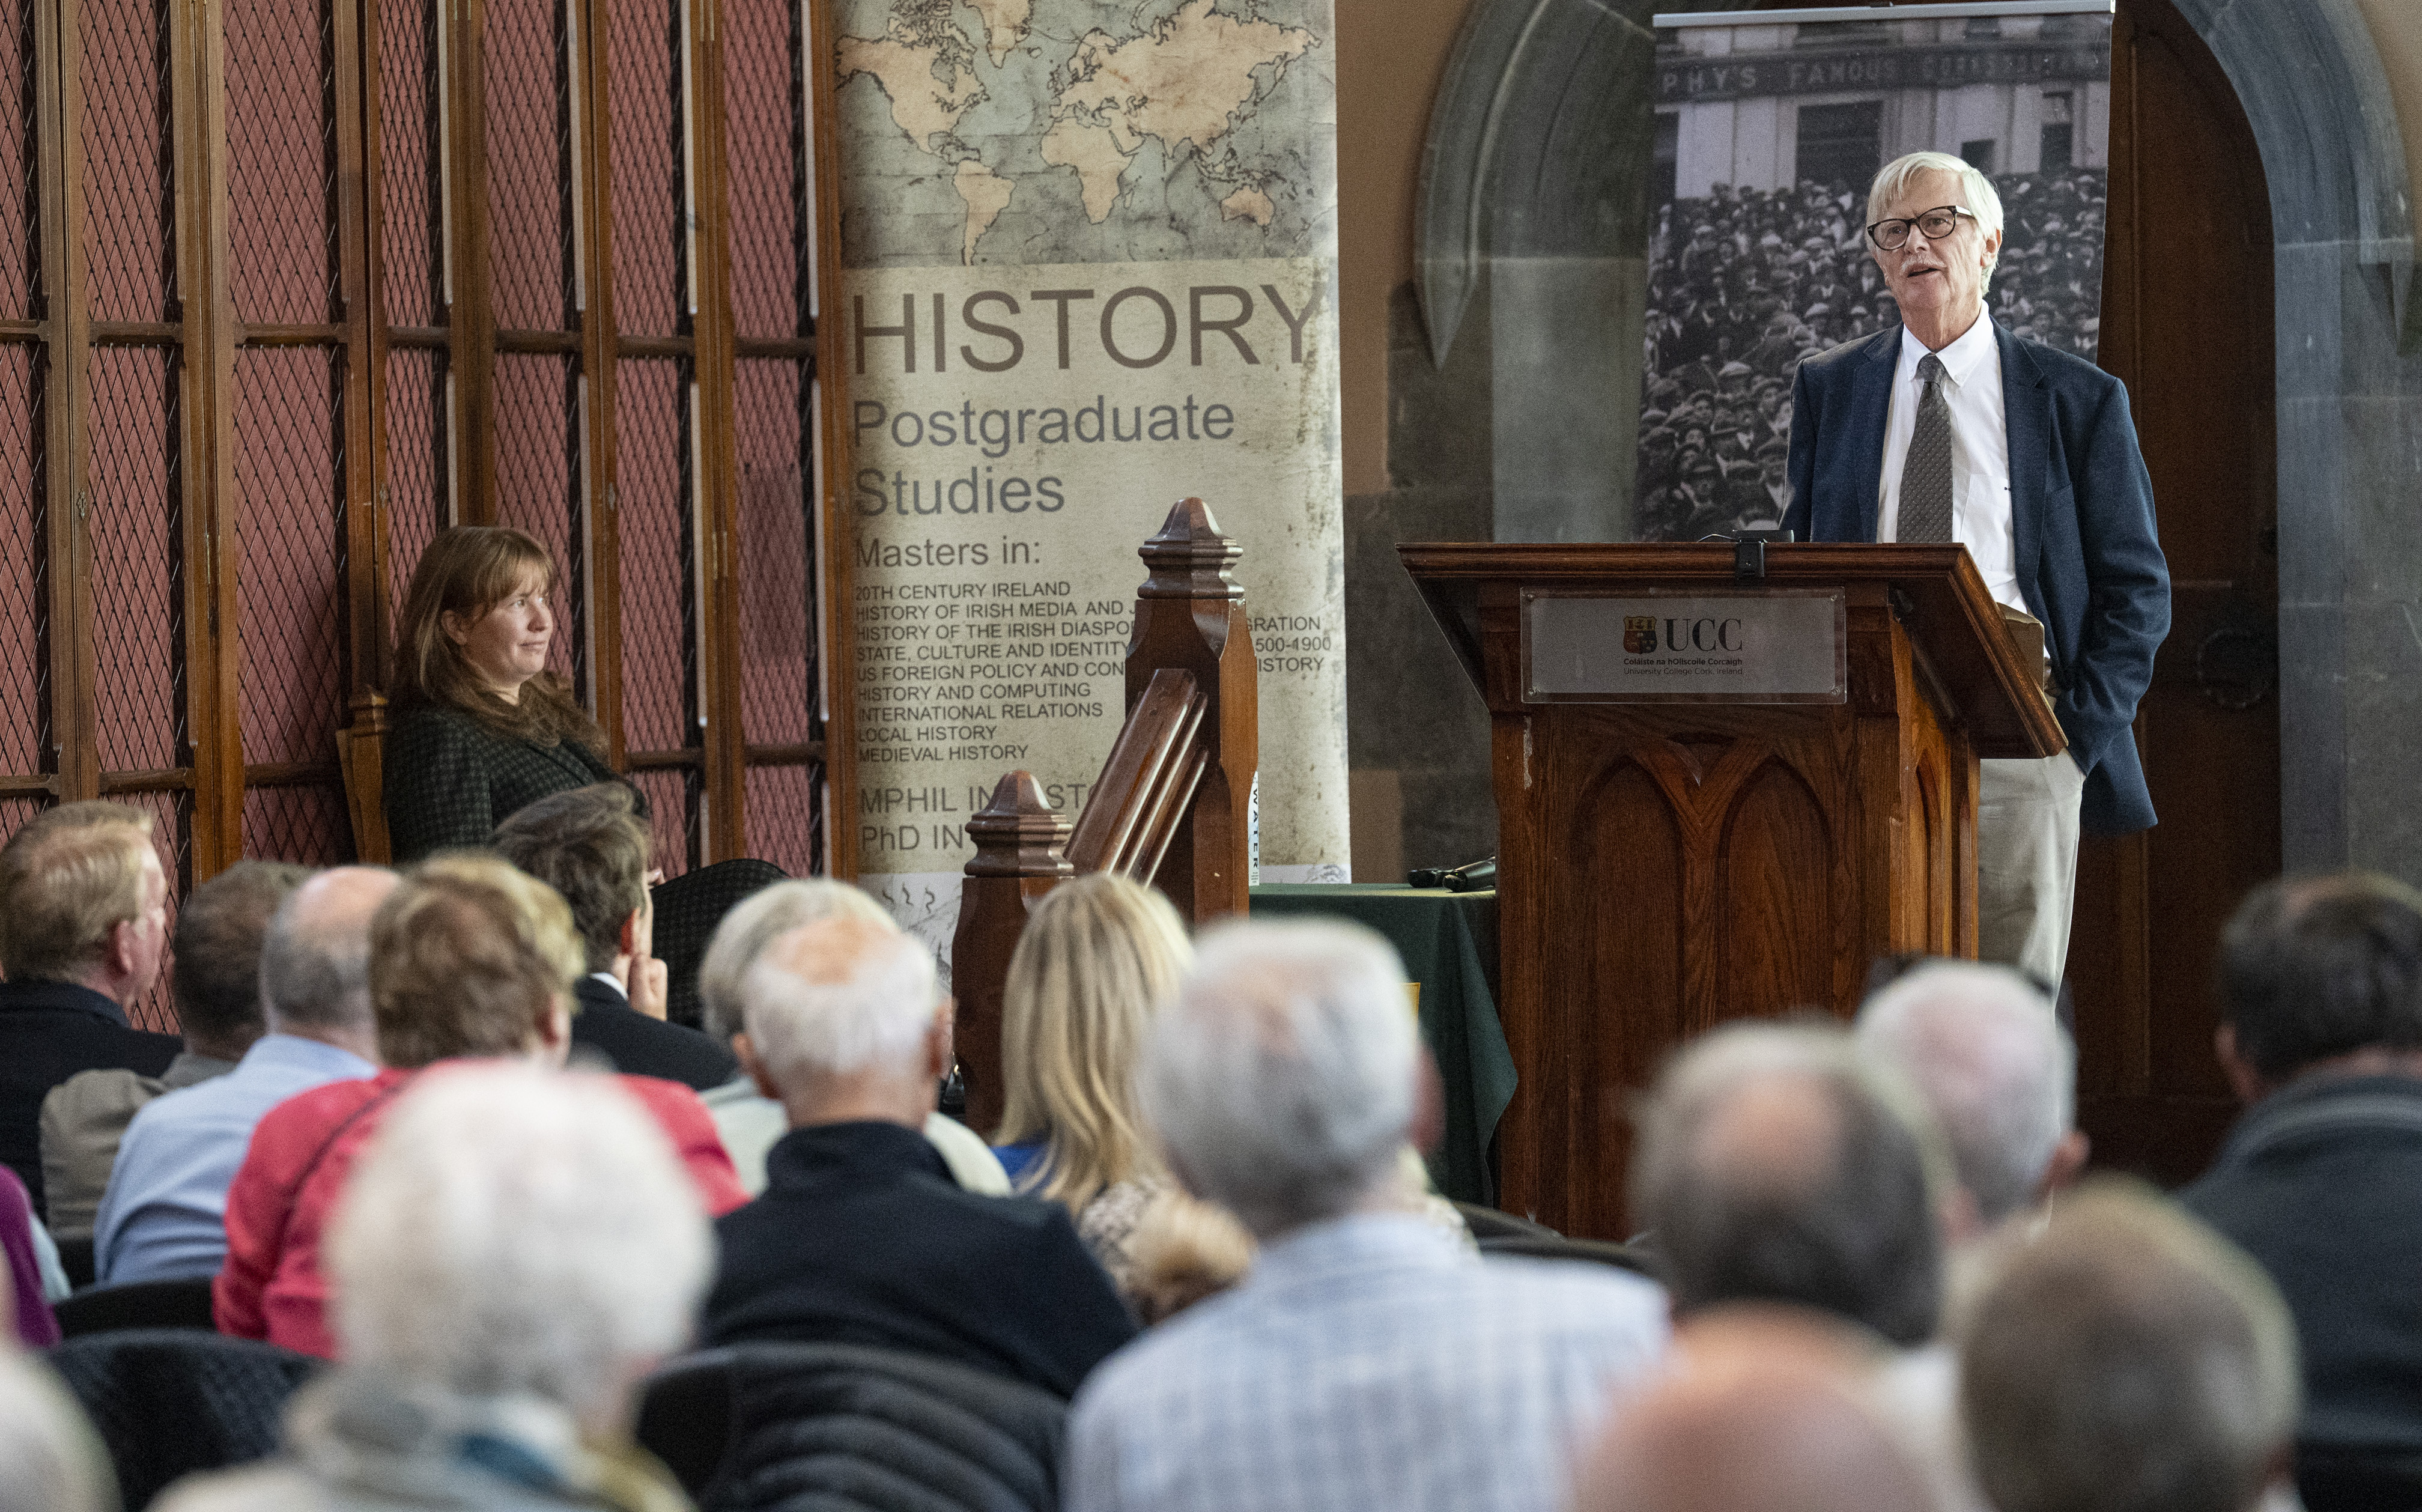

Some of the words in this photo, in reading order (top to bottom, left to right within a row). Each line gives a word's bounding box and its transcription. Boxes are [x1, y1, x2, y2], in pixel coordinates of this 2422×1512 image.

[853, 284, 1322, 375] HISTORY
[854, 395, 1234, 458] Postgraduate
[855, 467, 1064, 517] Studies
[856, 538, 989, 568] Masters
[1003, 535, 1040, 564] in:
[855, 586, 893, 601] 20TH
[899, 583, 986, 599] CENTURY
[992, 581, 1070, 597] IRELAND
[857, 606, 928, 621] HISTORY
[935, 605, 959, 619] OF
[966, 604, 1013, 618] IRISH
[1021, 603, 1076, 616] MEDIA
[1085, 601, 1123, 615] AND
[857, 626, 929, 641] HISTORY
[936, 625, 960, 639] OF
[965, 624, 1001, 639] THE
[1007, 622, 1055, 637] IRISH
[1062, 621, 1136, 636] DIASPO
[1663, 619, 1743, 651] UCC
[857, 646, 911, 661] STATE,
[917, 644, 1001, 660] CULTURE
[1006, 643, 1044, 658] AND
[1255, 637, 1331, 652] 500-1900
[858, 667, 876, 681] US
[882, 665, 964, 680] FOREIGN
[971, 664, 1036, 678] POLICY
[1042, 663, 1078, 676] AND
[1084, 661, 1124, 676] CON
[1258, 657, 1323, 672] ISTORY
[858, 686, 931, 702] HISTORY
[936, 685, 973, 699] AND
[980, 683, 1090, 699] COMPUTING
[858, 705, 997, 721] INTERNATIONAL
[1002, 703, 1103, 718] RELATIONS
[858, 727, 911, 742] LOCAL
[917, 725, 997, 740] HISTORY
[859, 747, 943, 762] MEDIEVAL
[949, 745, 1028, 759] HISTORY
[861, 787, 957, 813] MPHIL
[862, 825, 919, 851] PhD
[934, 824, 962, 849] IN
